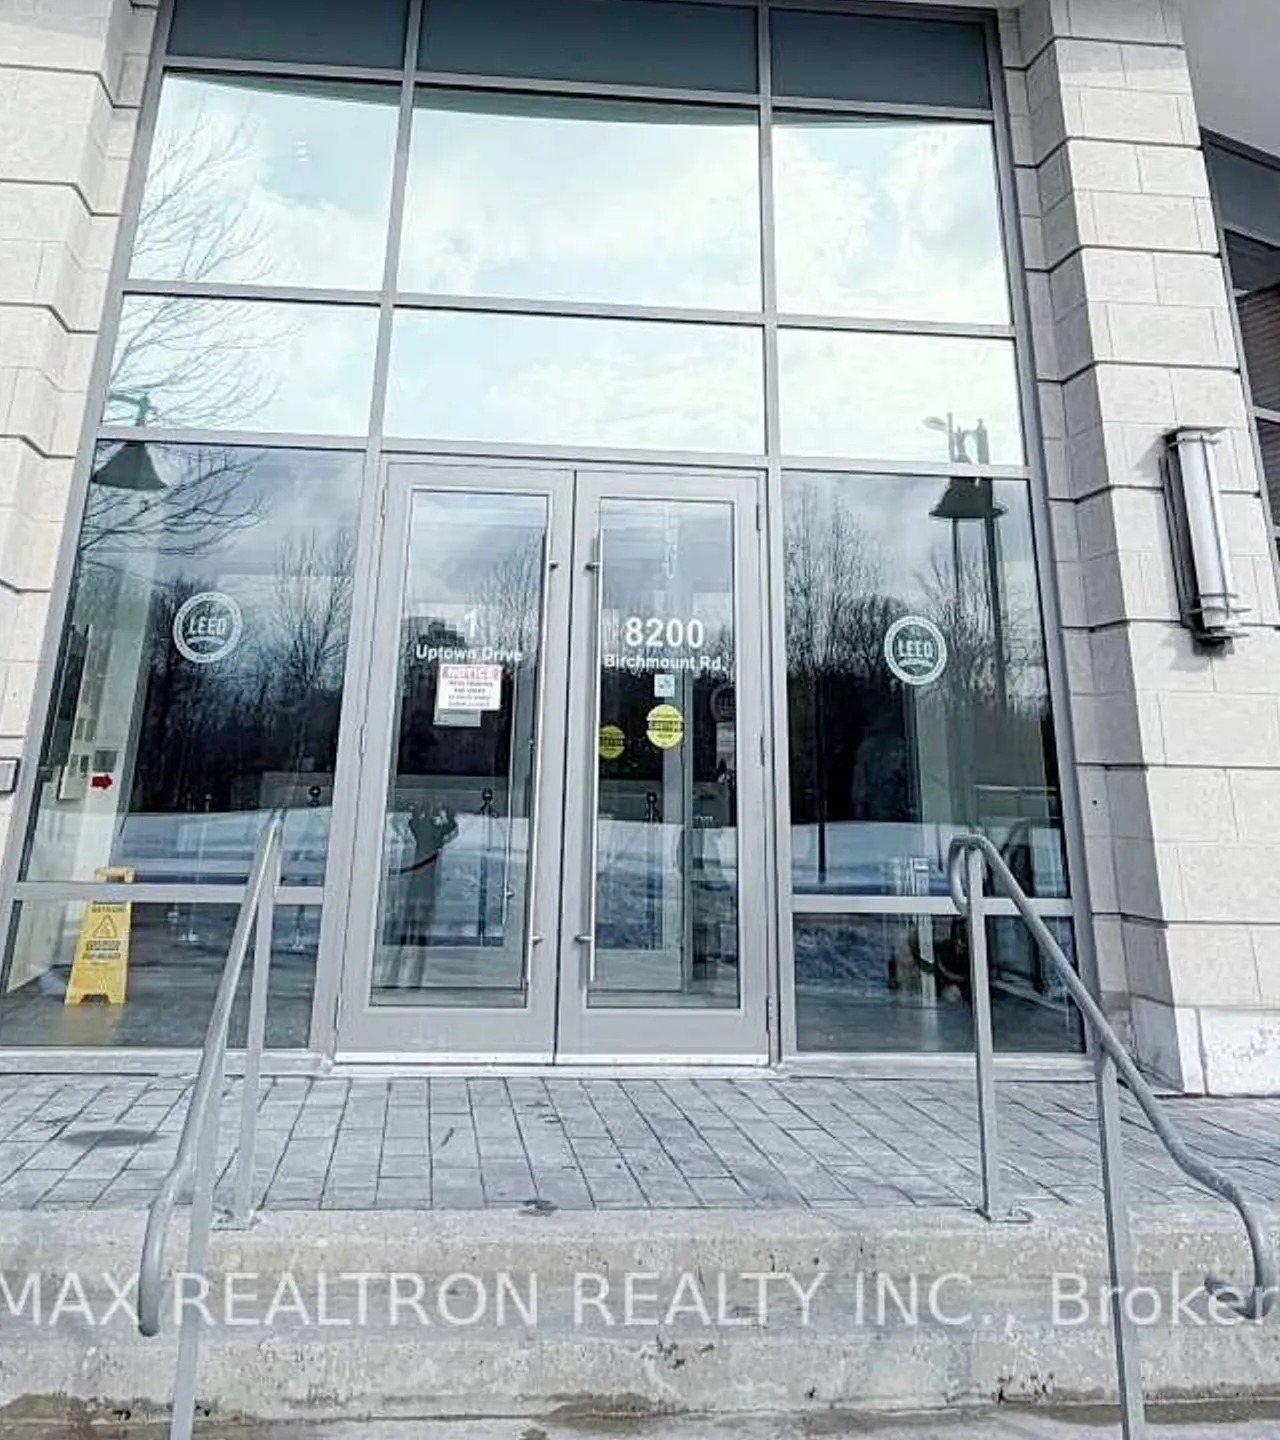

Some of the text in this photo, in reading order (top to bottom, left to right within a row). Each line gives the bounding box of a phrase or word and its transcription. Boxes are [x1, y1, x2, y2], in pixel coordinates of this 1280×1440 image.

[464, 610, 477, 638] 1
[625, 616, 704, 648] 8200
[416, 644, 523, 661] Uptown Drive
[603, 653, 727, 672] Birchmount Rd.
